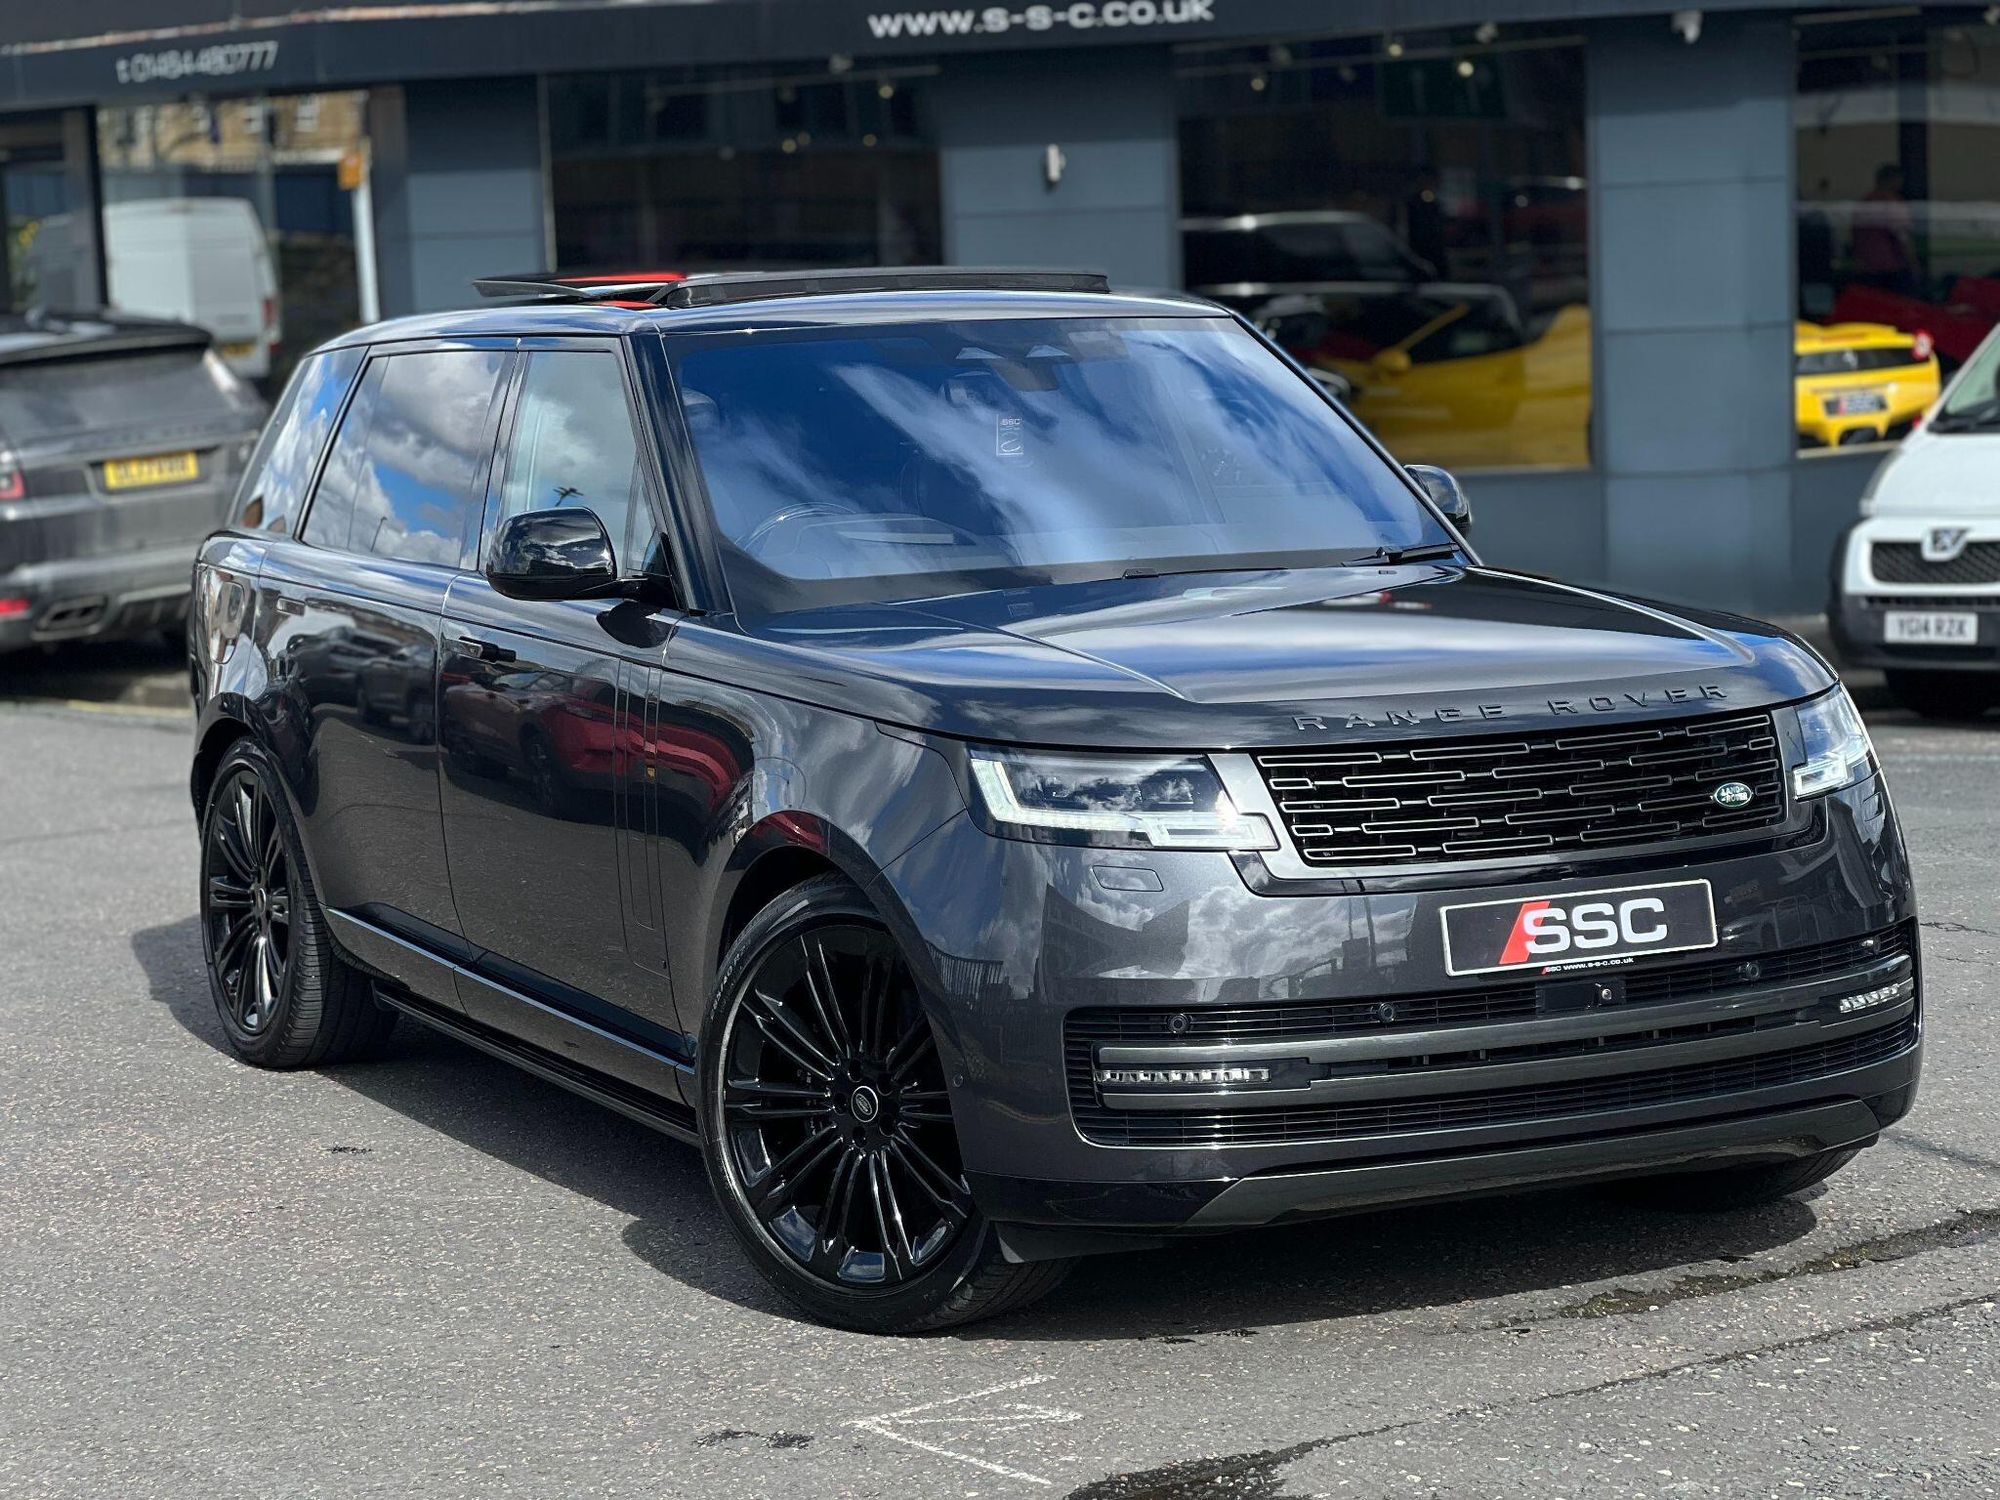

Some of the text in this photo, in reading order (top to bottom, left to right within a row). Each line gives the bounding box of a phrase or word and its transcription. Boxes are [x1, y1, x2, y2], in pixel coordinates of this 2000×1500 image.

[867, 0, 1215, 38] www.s-s-c.co.uk
[1292, 684, 1727, 731] RANGE ROVER
[1523, 897, 1668, 954] SSC
[1563, 957, 1634, 971] www.s-s-c.co.uk
